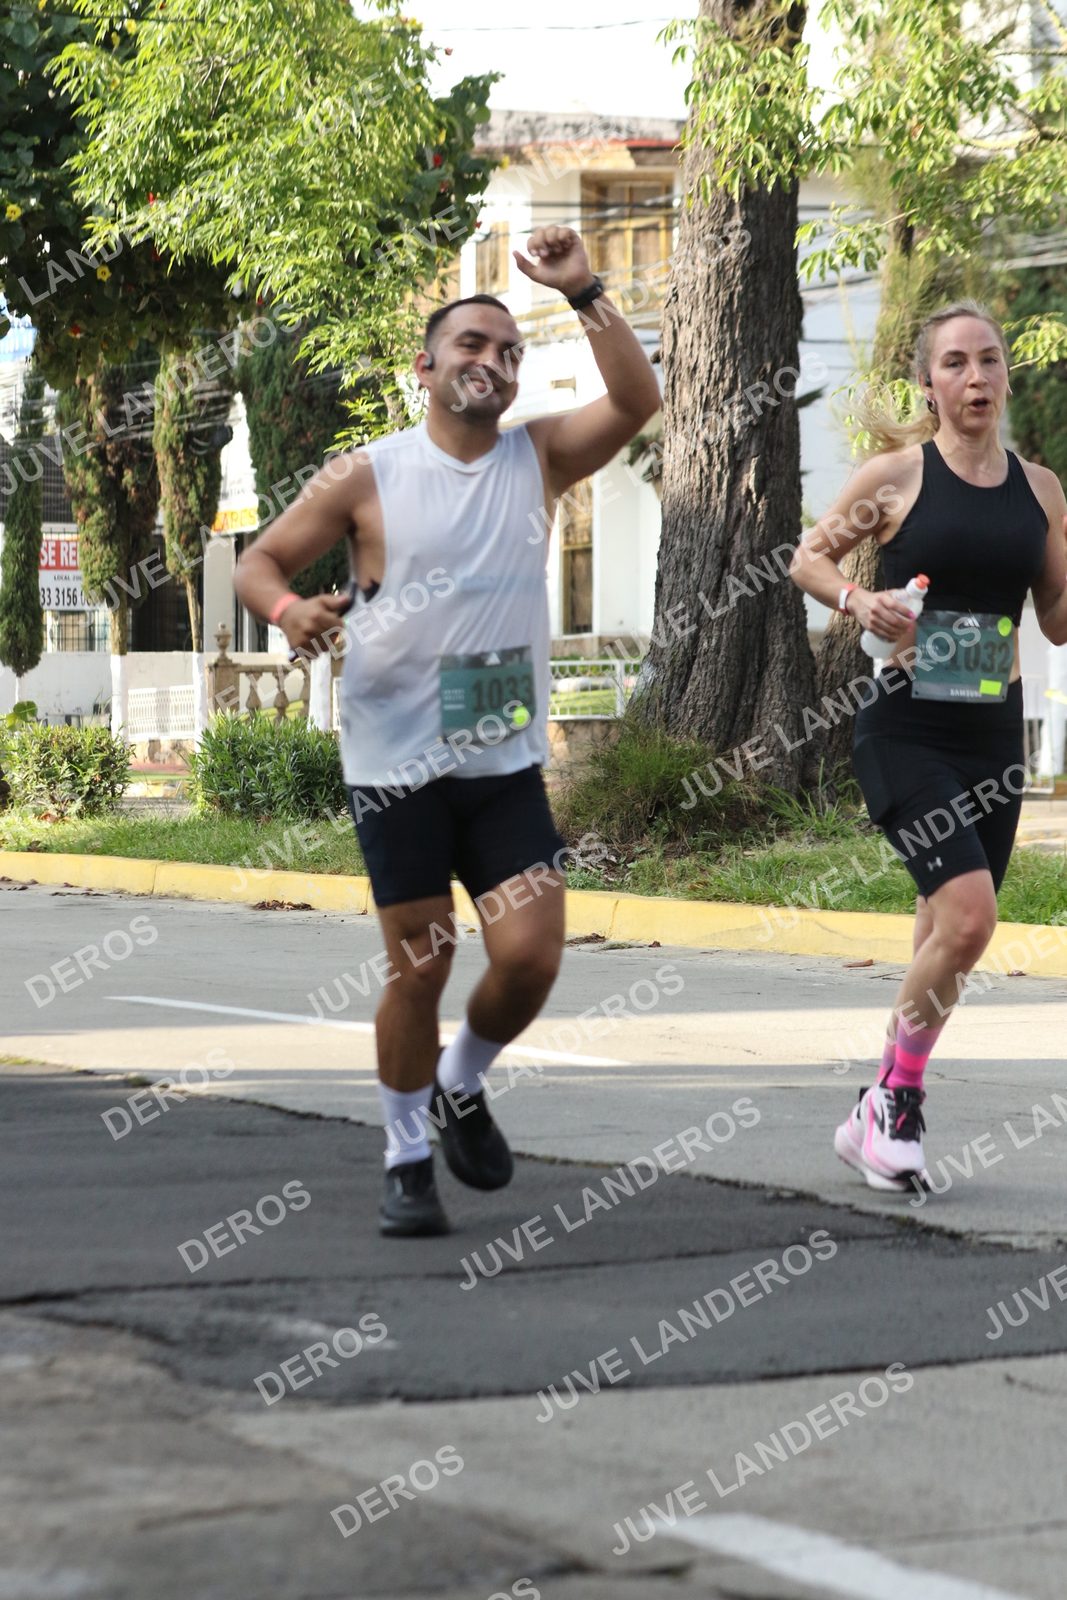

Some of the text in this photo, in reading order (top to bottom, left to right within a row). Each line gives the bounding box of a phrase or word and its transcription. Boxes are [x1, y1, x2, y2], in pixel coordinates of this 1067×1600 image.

[40, 541, 56, 566] SE
[41, 587, 51, 606] 33
[55, 587, 77, 607] 3156
[945, 640, 1011, 674] 1032
[472, 672, 533, 713] 1033
[950, 688, 983, 698] SAMSUN
